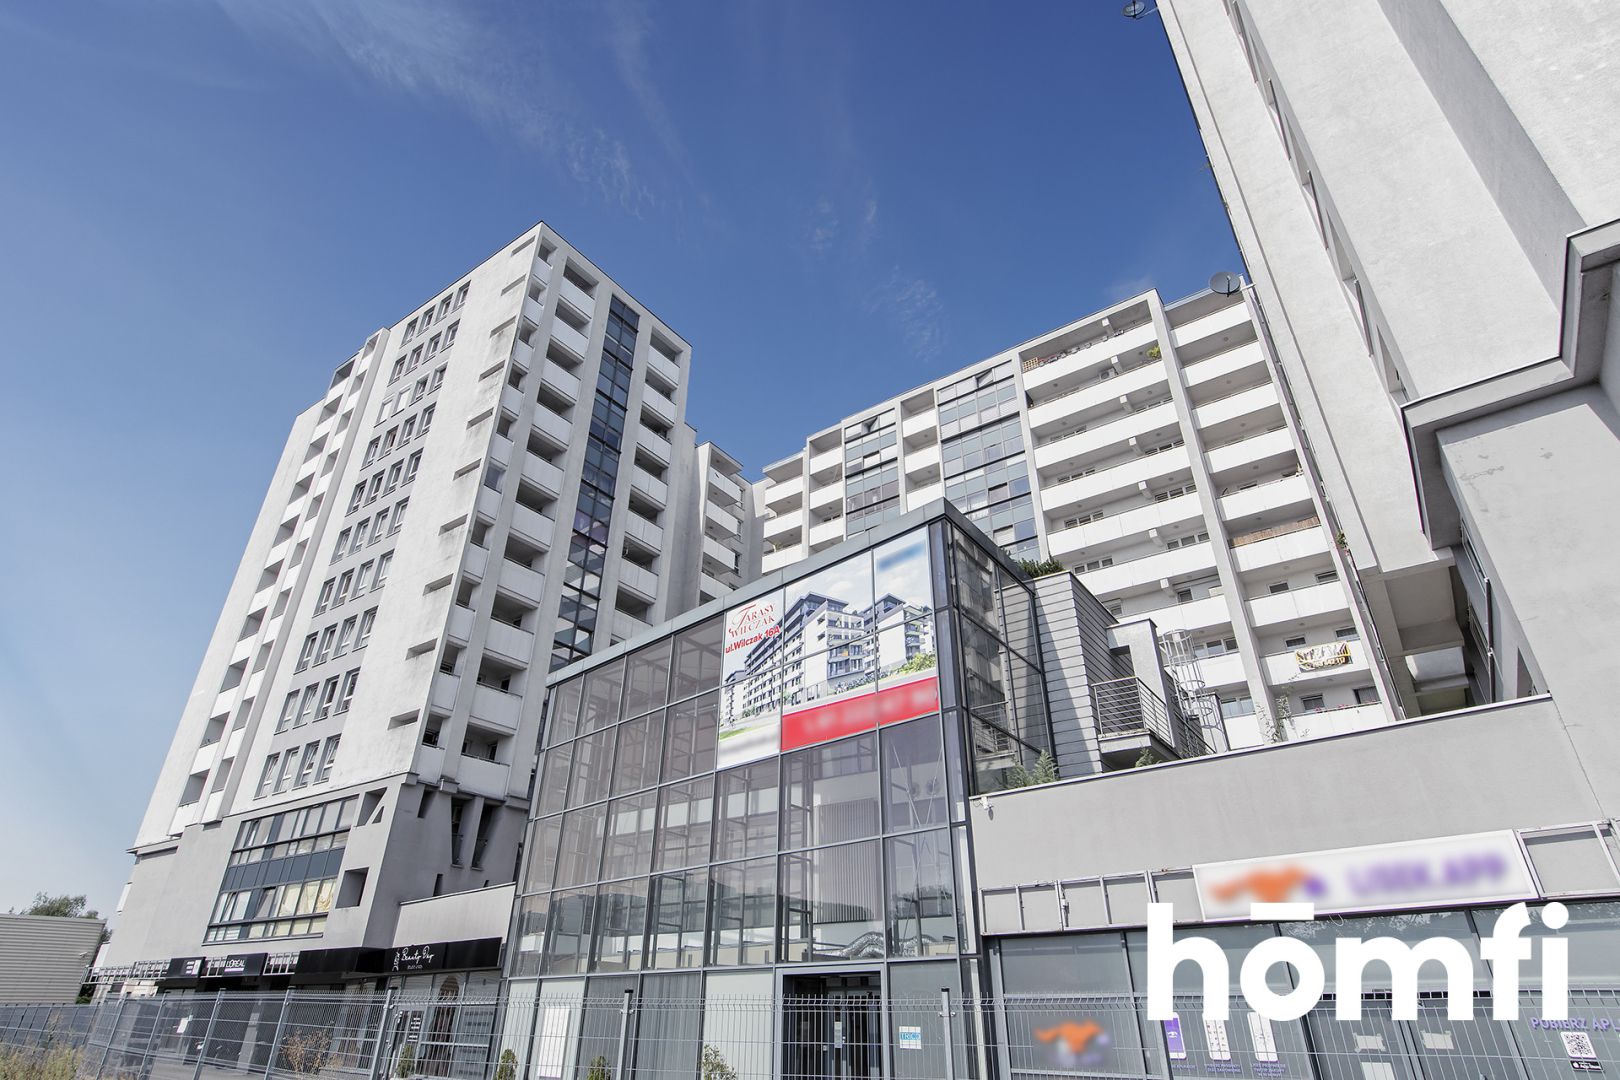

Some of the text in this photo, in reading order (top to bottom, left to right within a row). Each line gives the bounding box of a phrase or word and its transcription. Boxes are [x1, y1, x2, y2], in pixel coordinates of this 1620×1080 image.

[729, 615, 775, 637] WILCZAK
[732, 604, 775, 629] TARASY
[726, 625, 781, 654] ul.Wilczak 16A
